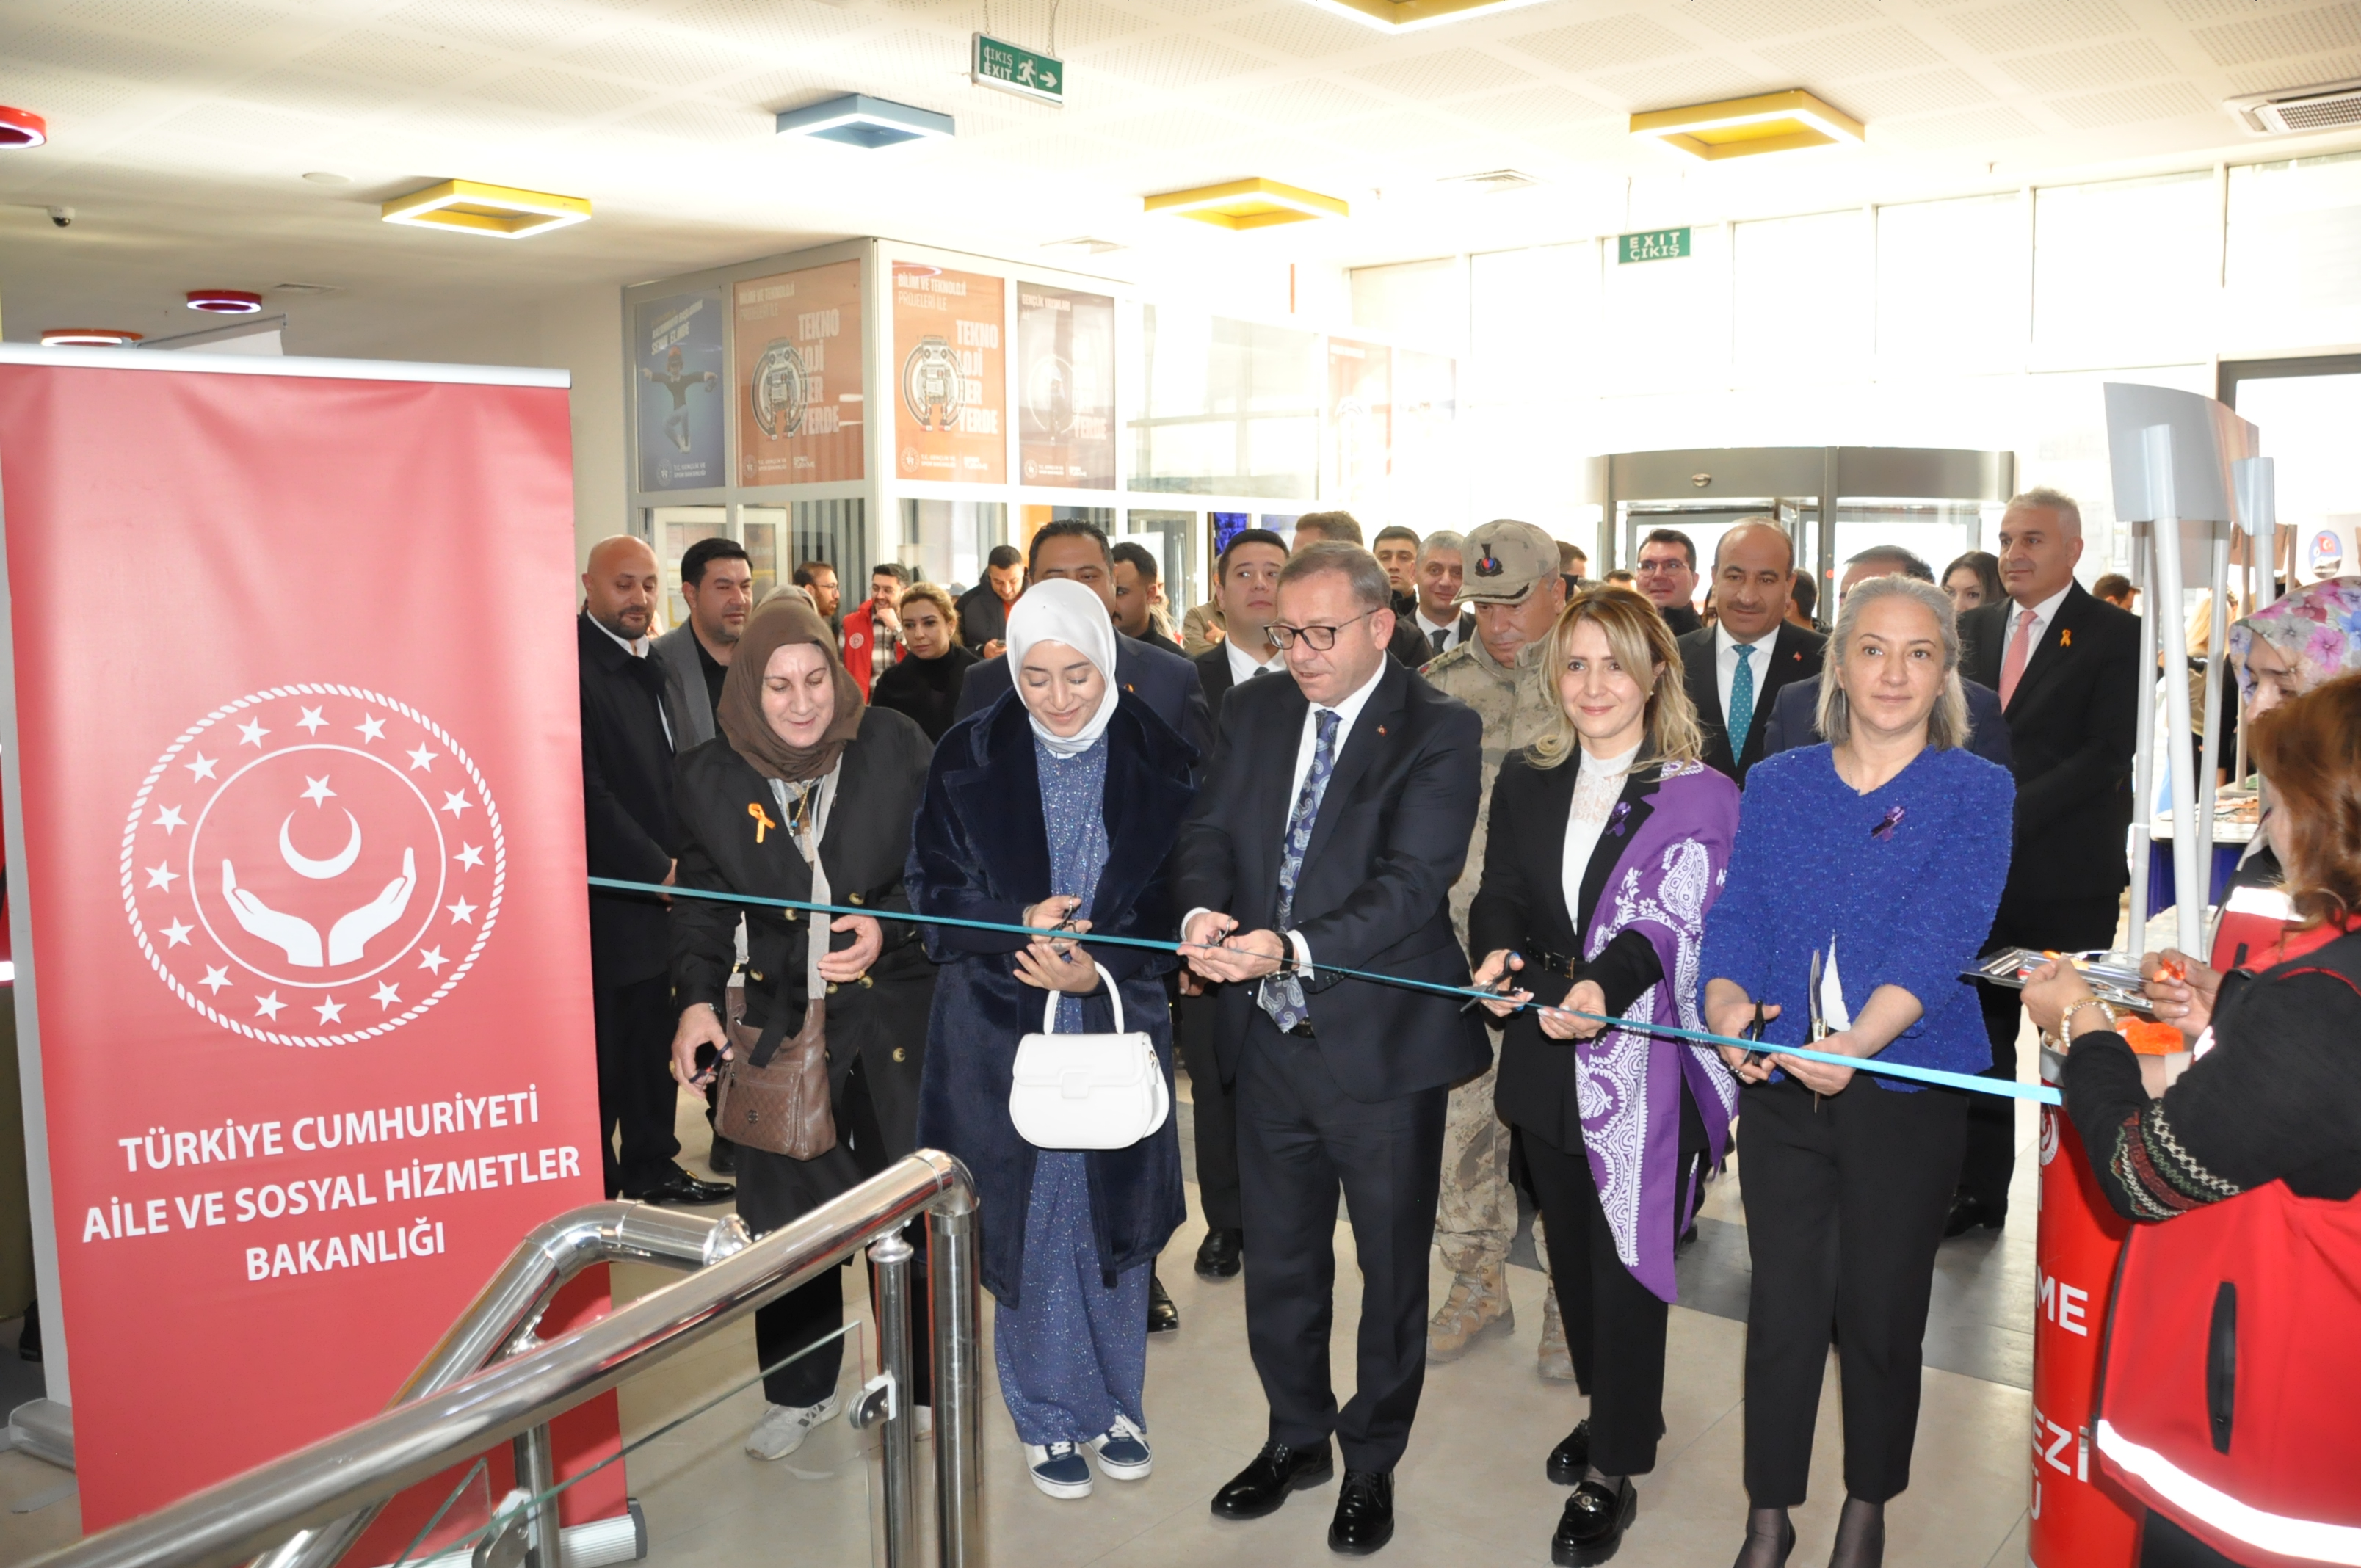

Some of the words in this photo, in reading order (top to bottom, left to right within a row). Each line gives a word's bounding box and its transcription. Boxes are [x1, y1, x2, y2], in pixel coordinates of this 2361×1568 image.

[984, 47, 1013, 68] ÇIKIŞ
[984, 62, 1012, 81] EXIT
[1629, 232, 1680, 249] EXIT
[1630, 244, 1680, 261] ÇIKIŞ
[898, 272, 919, 289] BİLİM
[921, 277, 929, 291] VE
[930, 278, 966, 297] TEKNOLOJİ
[899, 291, 935, 309] PROJELERİ
[798, 308, 840, 341] TEKNO
[956, 319, 999, 349] TEKNO
[799, 405, 840, 435] YERDE
[957, 406, 998, 435] YERDE
[118, 1119, 284, 1172] TÜRKİYE
[292, 1083, 539, 1151] CUMHURİYETİ
[82, 1196, 170, 1243] AİLE
[174, 1191, 226, 1230] VE
[235, 1173, 377, 1222] SOSYAL
[385, 1146, 581, 1202] HİZMETLER
[245, 1216, 446, 1282] BAKANLIĞI
